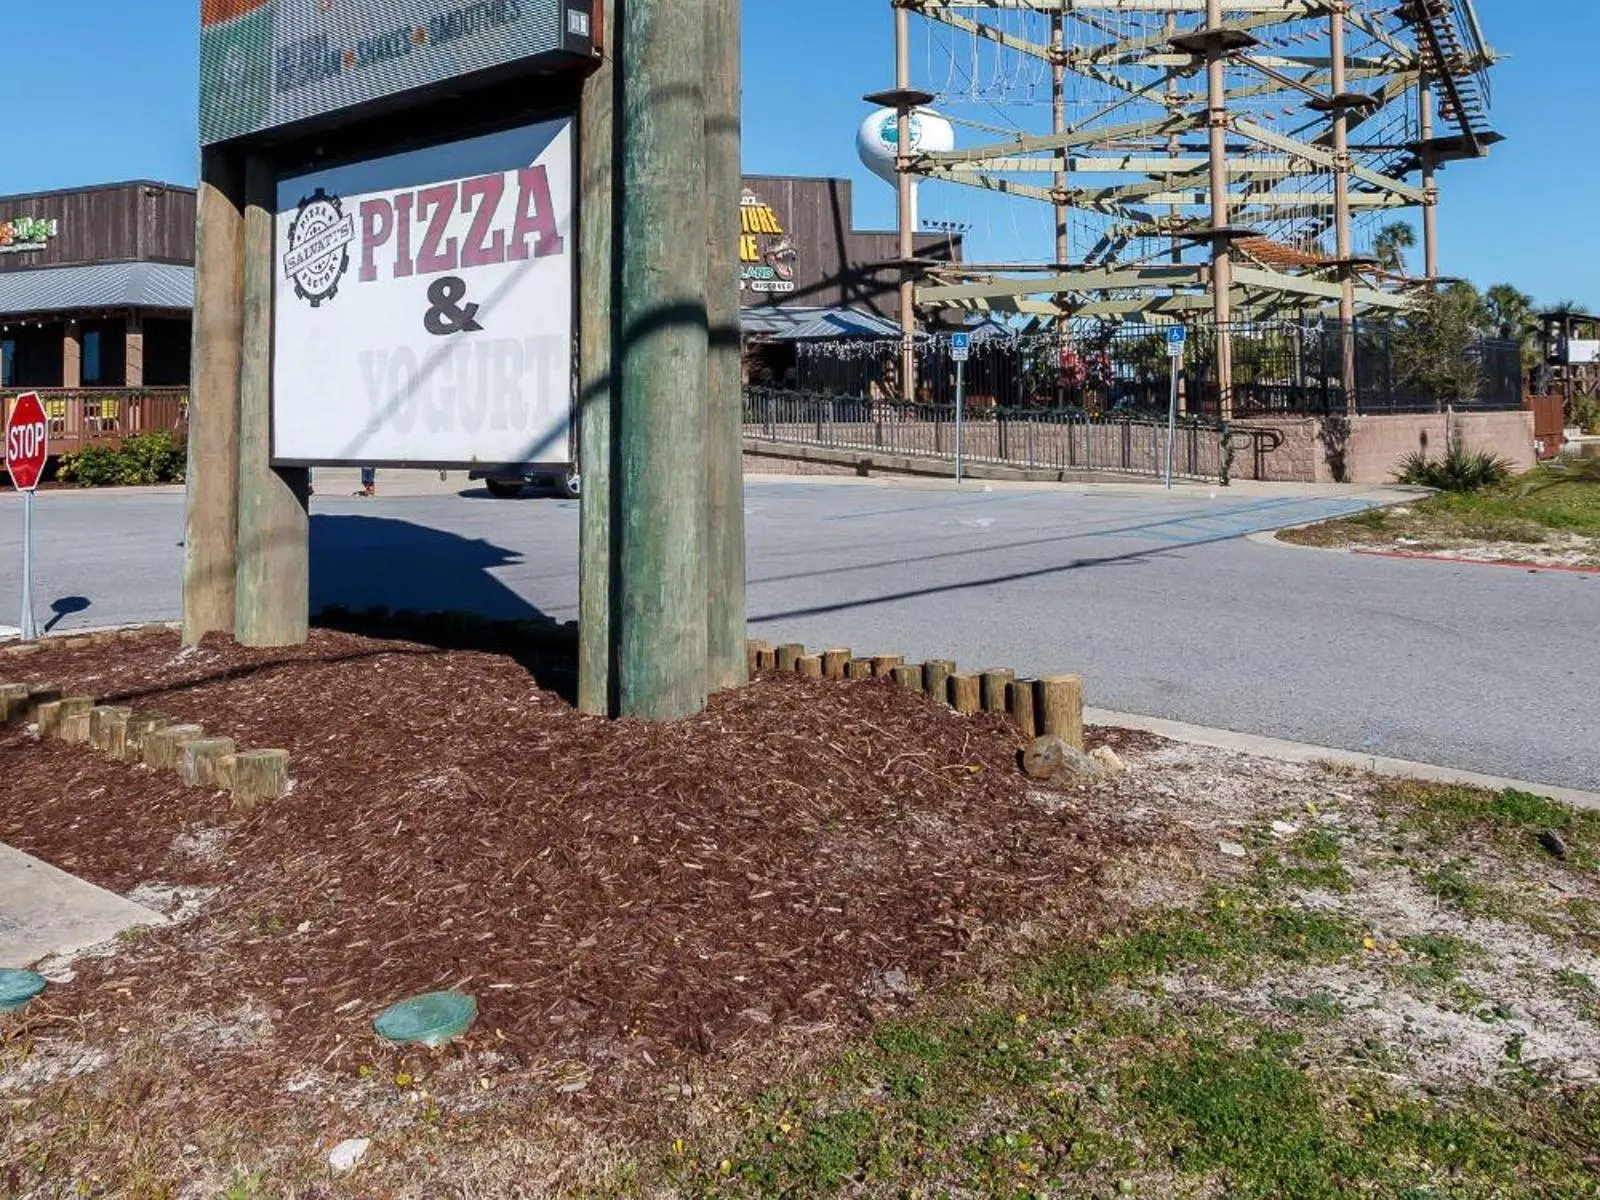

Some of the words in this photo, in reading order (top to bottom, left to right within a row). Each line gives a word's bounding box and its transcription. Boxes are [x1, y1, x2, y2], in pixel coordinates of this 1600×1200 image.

[358, 164, 564, 282] PIZZA
[423, 275, 485, 336] &
[357, 334, 564, 434] YOGURT
[9, 422, 45, 461] STOP
